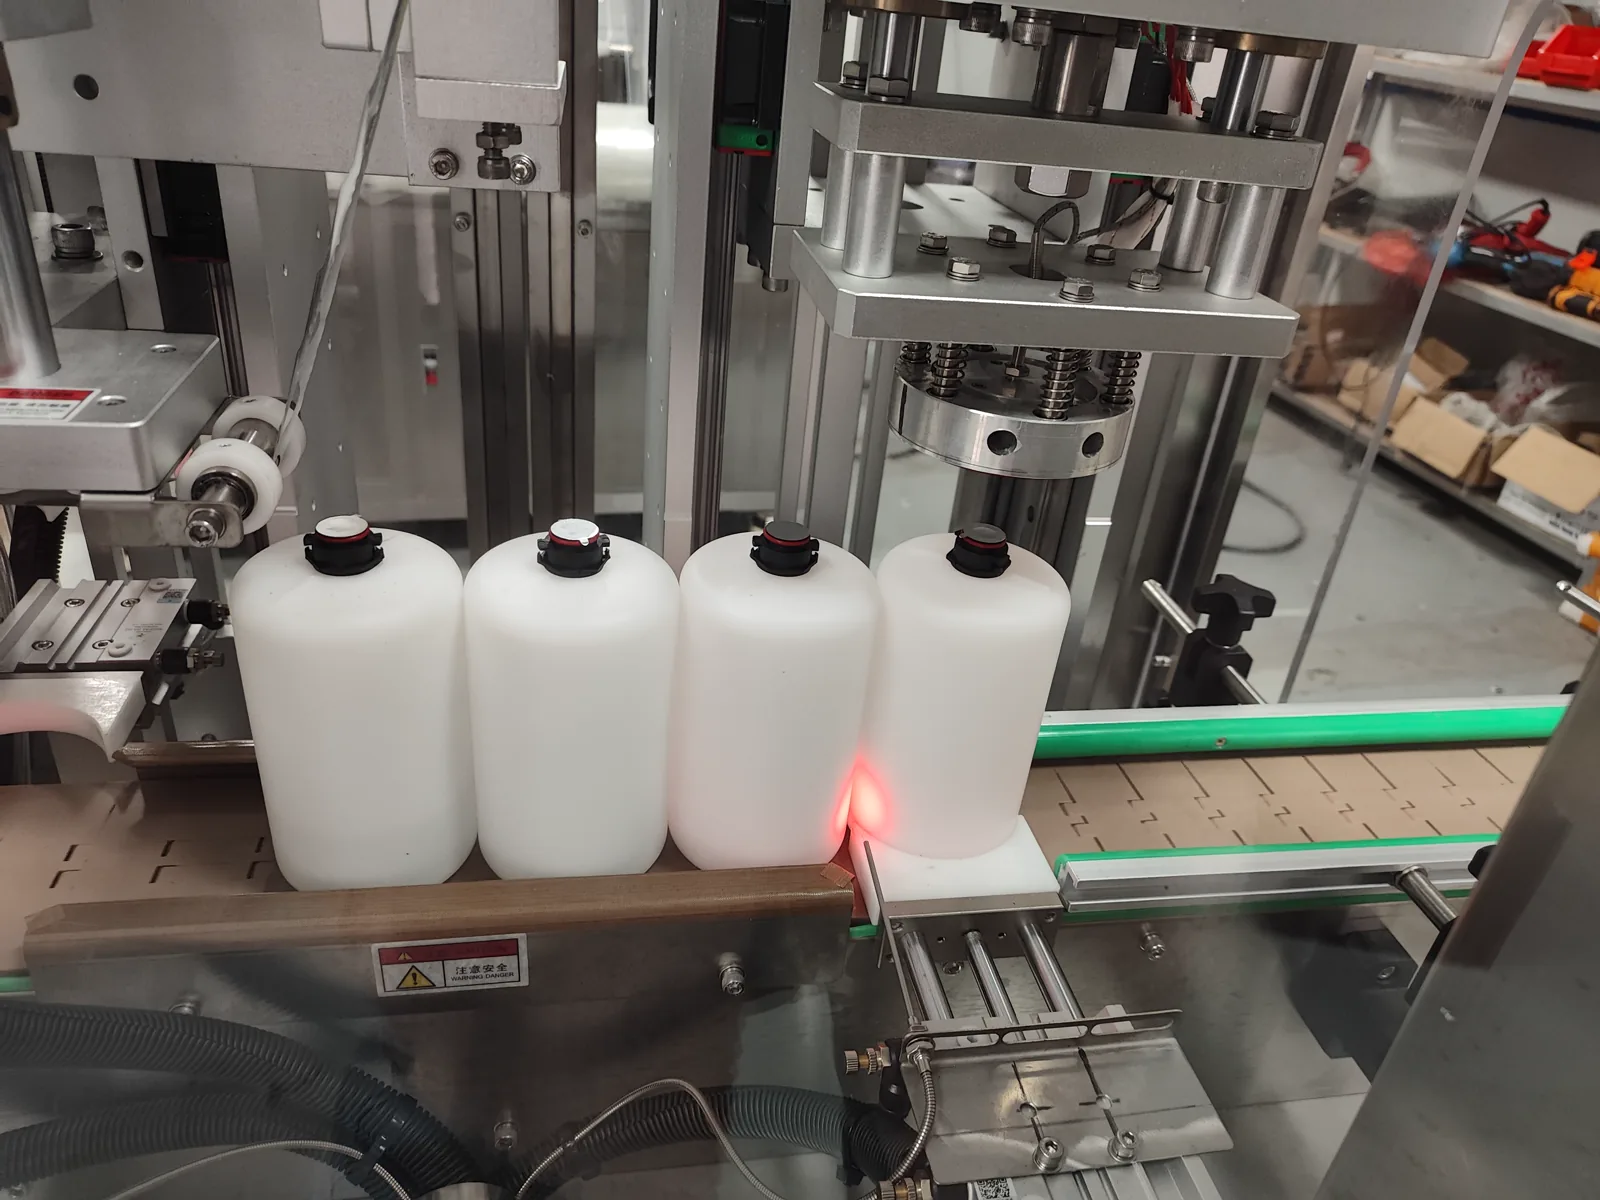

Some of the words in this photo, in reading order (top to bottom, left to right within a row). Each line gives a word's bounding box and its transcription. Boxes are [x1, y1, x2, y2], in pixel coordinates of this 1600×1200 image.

[455, 963, 508, 975] 注意安全
[485, 971, 514, 979] DANGER
